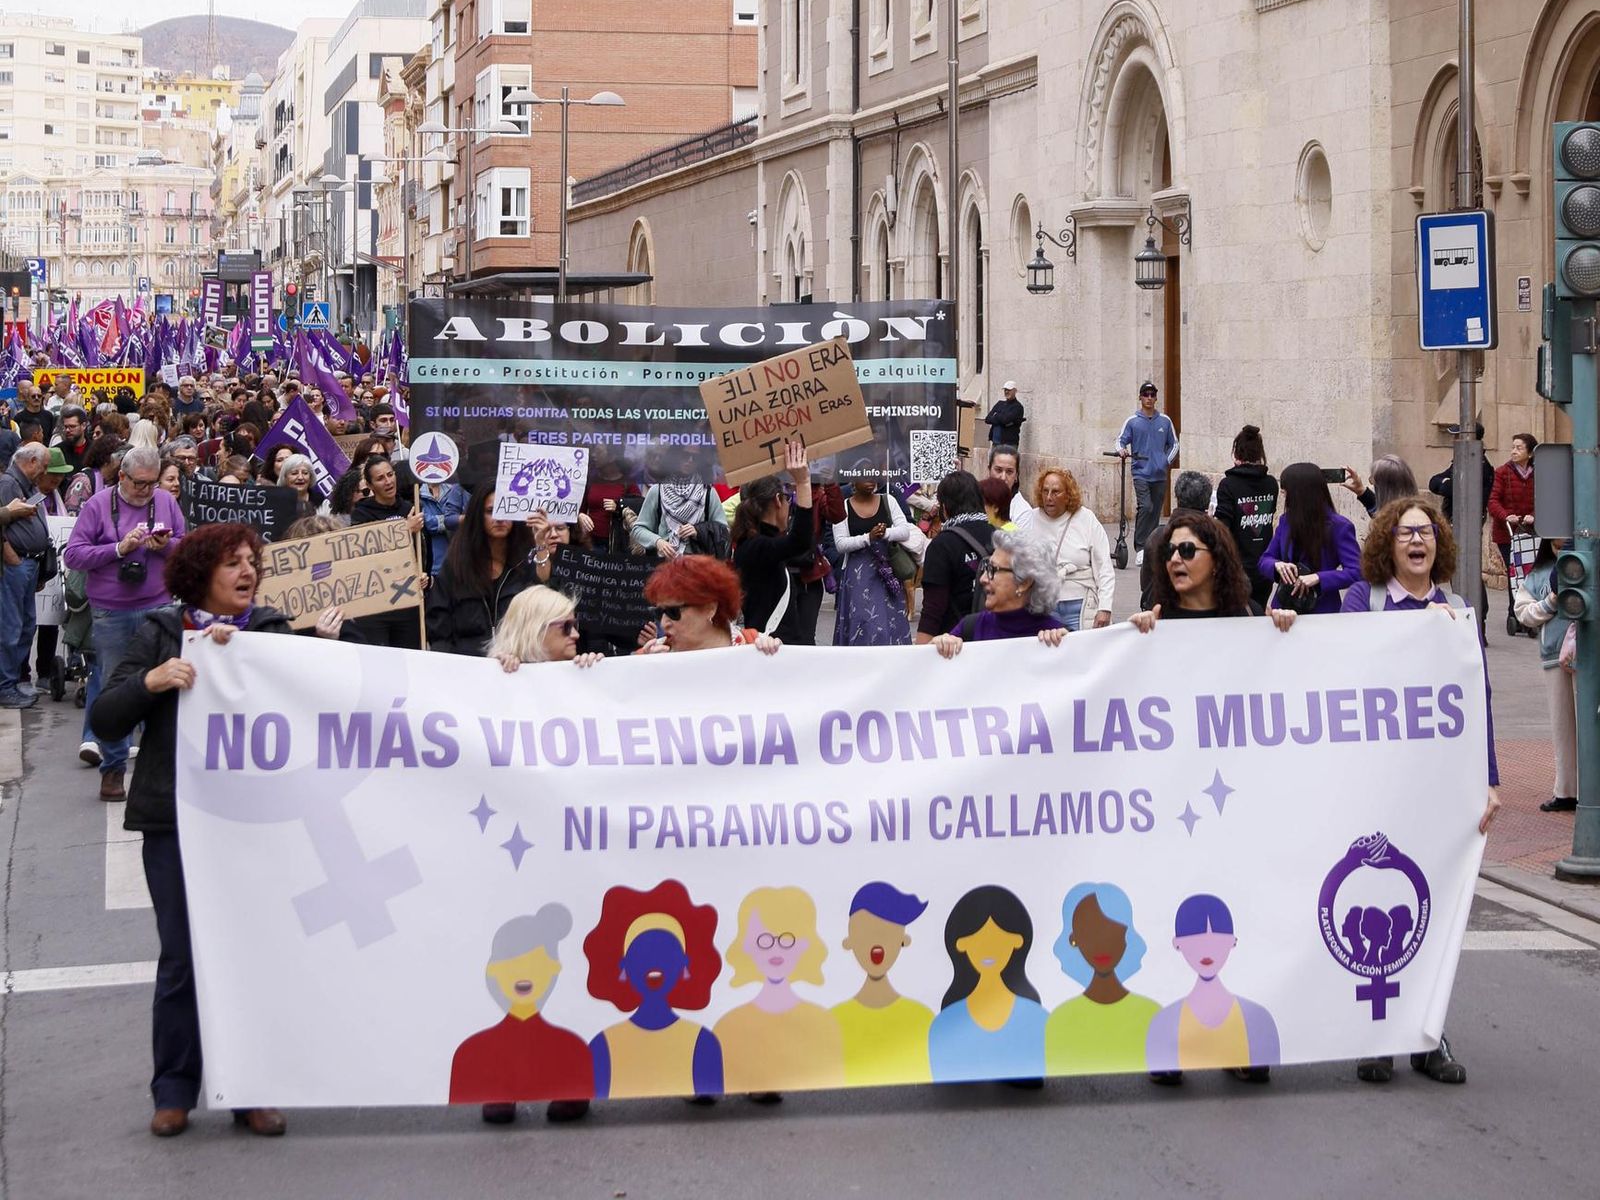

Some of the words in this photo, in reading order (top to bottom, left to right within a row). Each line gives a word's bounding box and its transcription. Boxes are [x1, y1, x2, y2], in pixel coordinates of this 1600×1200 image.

[205, 283, 221, 326] CCO
[417, 364, 482, 377] Género
[503, 365, 619, 380] Prostitución
[878, 364, 946, 381] alquiler
[763, 359, 801, 388] NO
[809, 343, 849, 373] ERA
[719, 400, 763, 424] UNA
[766, 376, 829, 409] ZORRA
[426, 406, 440, 417] SI
[443, 406, 460, 417] NO
[464, 406, 514, 418] LUCHAS
[517, 407, 568, 418] CONTRA
[571, 408, 613, 419] TODAS
[616, 408, 641, 420] LAS
[723, 430, 742, 448] EL
[743, 404, 812, 441] CABRÓN
[820, 394, 853, 415] ERAS
[528, 431, 568, 445] ERES
[572, 432, 622, 445] PARTE
[627, 433, 656, 445] DEL
[503, 446, 527, 460] EL
[535, 478, 552, 492] ES
[863, 468, 880, 477] info
[882, 468, 901, 479] aquí
[200, 483, 267, 506] ATREVES
[198, 504, 275, 525] TOCARME
[325, 522, 411, 562] TRANS
[555, 566, 571, 578] NO
[562, 549, 578, 563] EL
[582, 554, 623, 572] TERMINO
[264, 569, 385, 617] MORDAZA
[205, 712, 290, 771] NO
[317, 697, 460, 770] MÁS
[479, 713, 798, 767] VIOLENCIA
[820, 702, 1053, 766] CONTRA
[1072, 696, 1175, 753] LAS
[1199, 683, 1466, 749] MUJERES
[565, 805, 609, 851] NI
[628, 801, 852, 850] PARAMOS
[870, 797, 911, 842] NI
[928, 788, 1155, 841] CALLAMOS
[1321, 907, 1350, 967] PLATAFORMA
[1350, 960, 1382, 976] ACCIÓN
[1384, 940, 1419, 975] FEMINISTA
[1415, 898, 1429, 942] ALMERÍA
